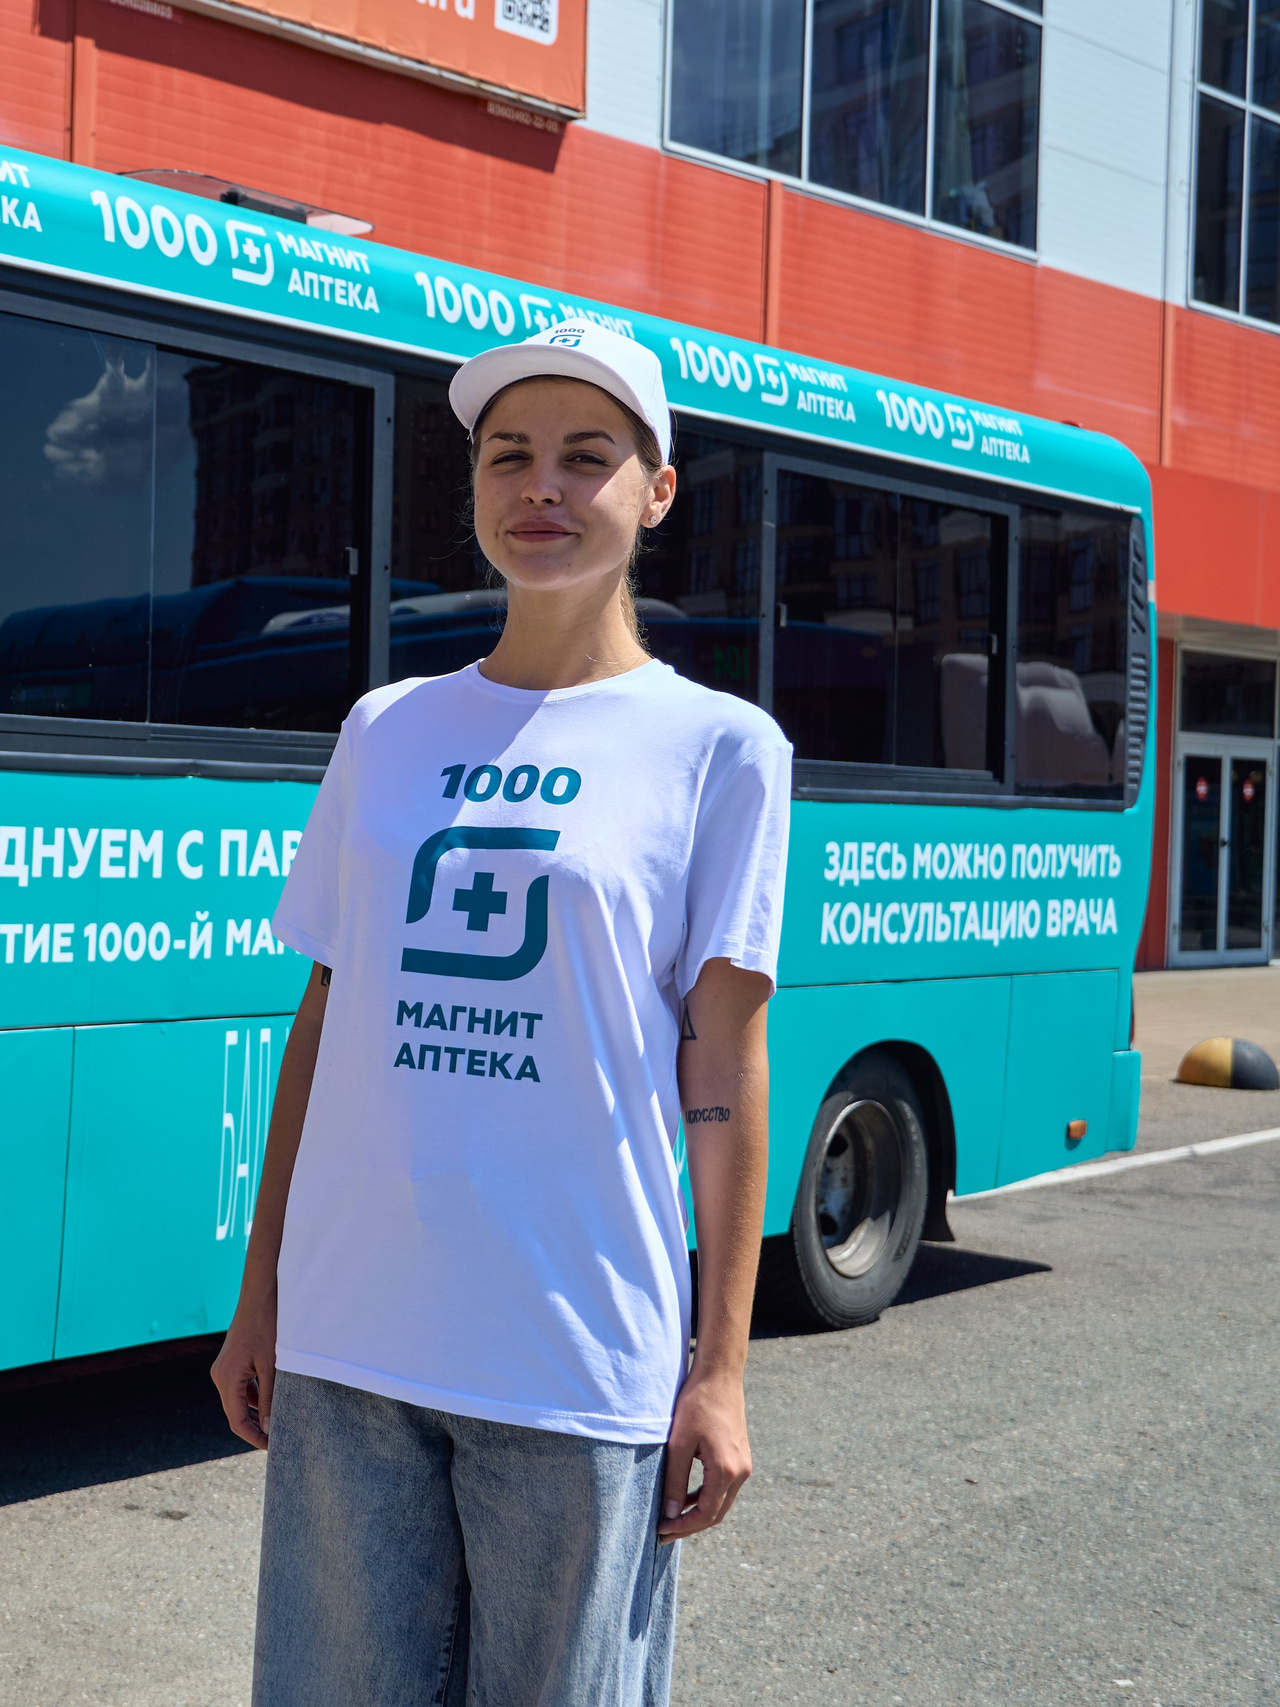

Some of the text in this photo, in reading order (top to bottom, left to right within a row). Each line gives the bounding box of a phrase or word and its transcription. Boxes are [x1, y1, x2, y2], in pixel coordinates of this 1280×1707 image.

[90, 190, 218, 267] 1000
[279, 231, 371, 275] МАГНИТ
[287, 275, 380, 314] АПТЕКА
[415, 271, 515, 337] 1000
[670, 336, 753, 394] 1000
[784, 360, 848, 393] МАГНИТ
[796, 389, 856, 424] АПТЕКА
[876, 389, 945, 440] 1000
[969, 409, 1023, 438] МАГНИТ
[980, 434, 1031, 464] АПТЕКА
[440, 763, 582, 805] 1000
[176, 830, 204, 880] С
[823, 841, 1121, 887] ЗДЕСЬ МОЖНО ПОЛУЧИТЬ
[83, 910, 213, 962] 1000-Й
[820, 898, 1118, 947] КОНСУЛЬТАЦИЮ ВРАЧА
[395, 1000, 543, 1039] МАГНИТ
[393, 1042, 541, 1083] АПТЕКА
[685, 1106, 730, 1125] ИСКУССТВО
